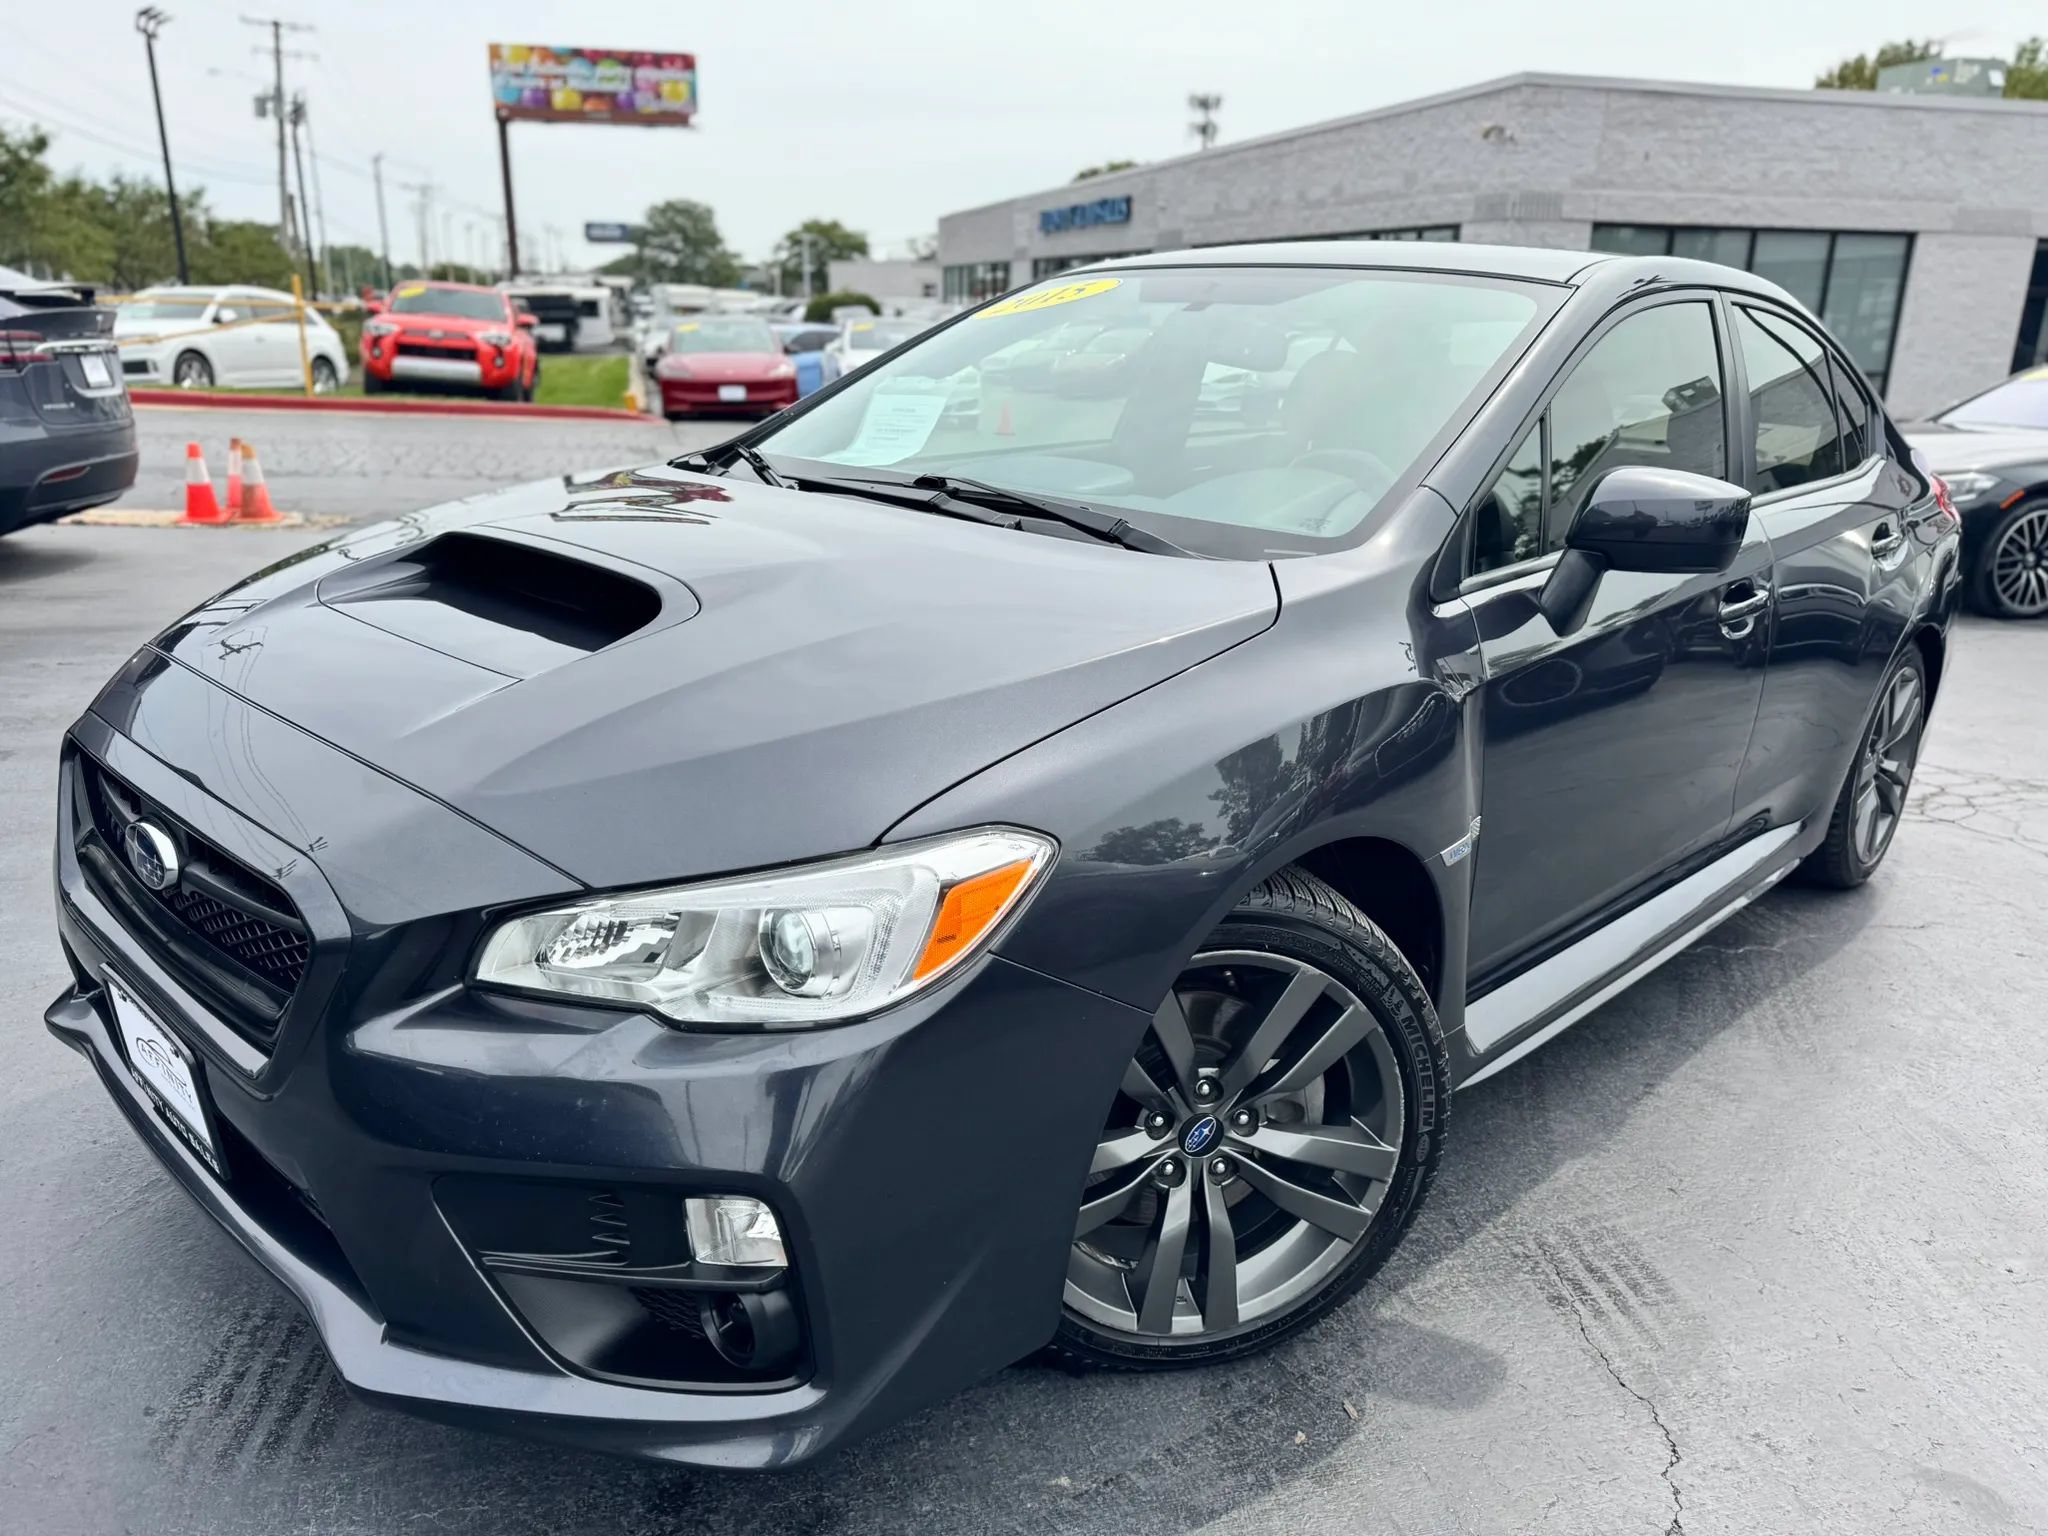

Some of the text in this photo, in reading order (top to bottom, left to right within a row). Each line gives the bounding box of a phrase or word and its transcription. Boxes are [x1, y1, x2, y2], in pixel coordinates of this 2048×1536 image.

[140, 1042, 193, 1104] AFFINITY
[1399, 1014, 1435, 1129] MICHELIN
[187, 1132, 220, 1174] SALES
